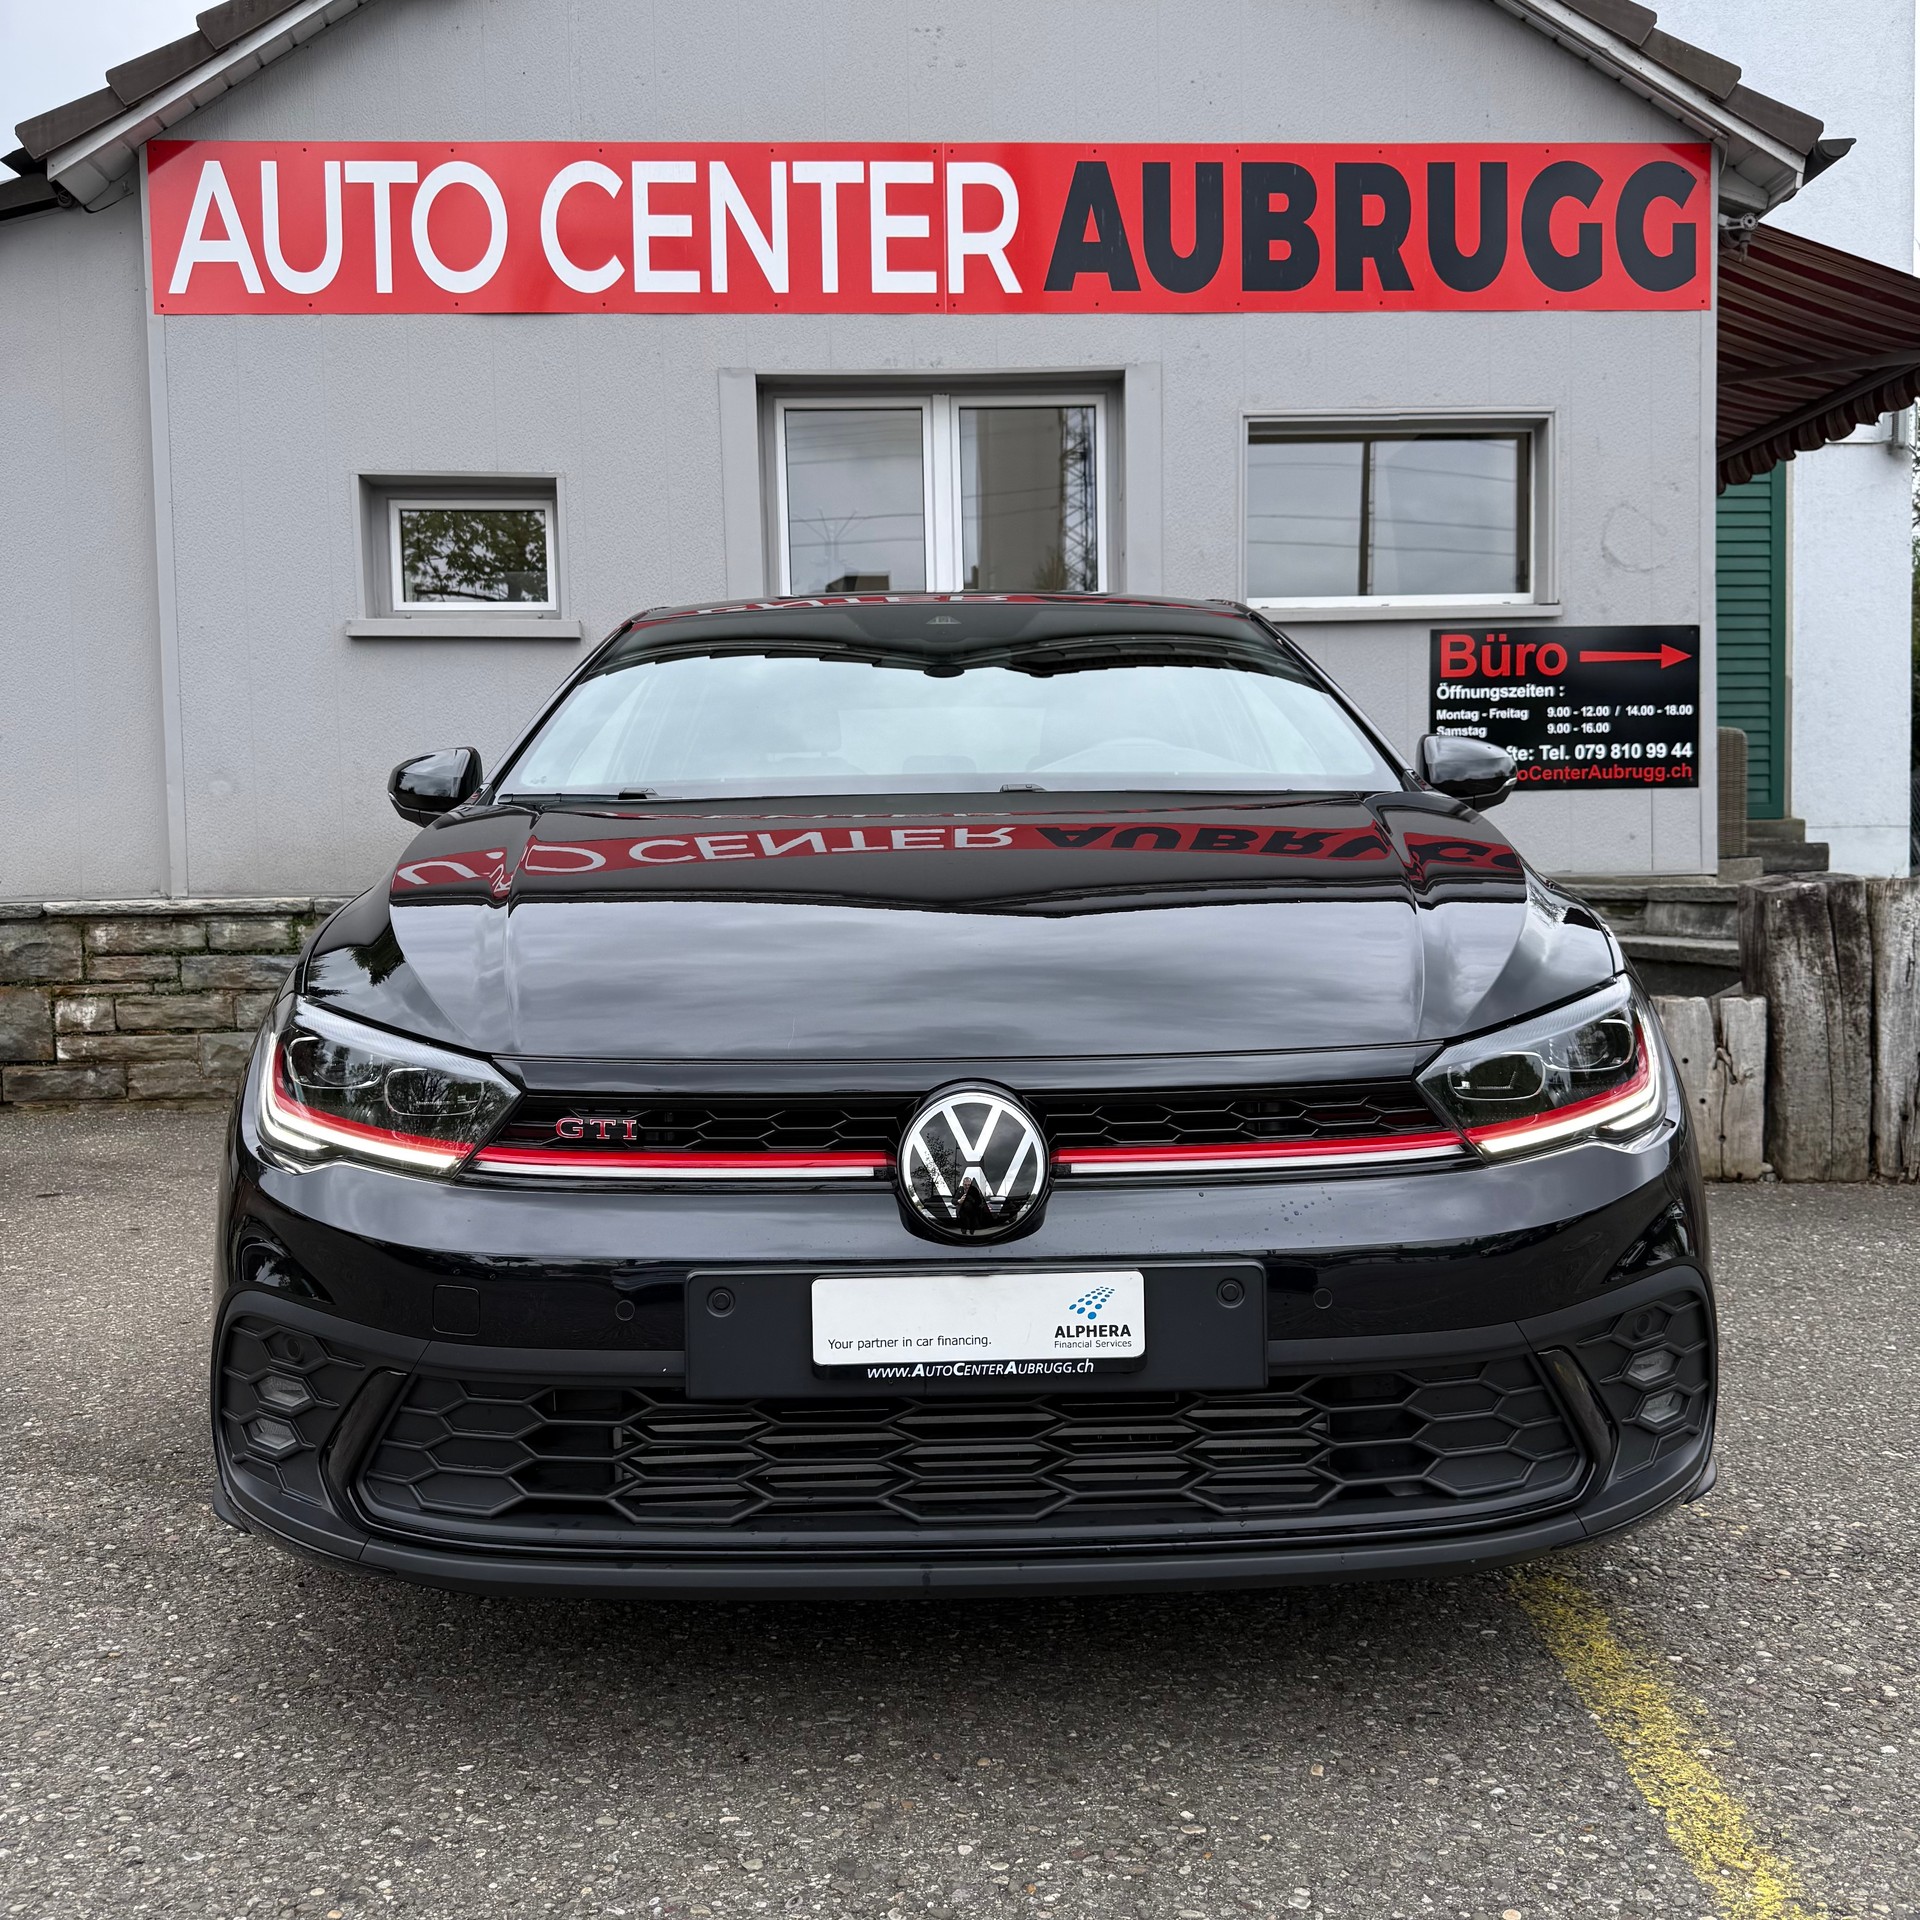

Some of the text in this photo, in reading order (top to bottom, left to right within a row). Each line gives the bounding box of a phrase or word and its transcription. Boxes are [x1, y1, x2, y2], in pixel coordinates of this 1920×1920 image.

[168, 160, 1698, 295] AUTO CENTER AUBRUGG
[1439, 633, 1568, 679] Büro
[1436, 682, 1555, 702] Öffnungszeiten
[1436, 709, 1480, 722] Montag
[1489, 707, 1530, 721] Freitag
[1546, 706, 1572, 718] 9.00
[1580, 705, 1611, 718] 12.00
[1625, 704, 1656, 717] 14.00
[1664, 704, 1694, 716] 18.00
[1436, 725, 1488, 738] Samstag
[1546, 722, 1572, 734] 9.00
[1580, 722, 1611, 734] 16.00
[1539, 744, 1571, 761] Tel.
[1574, 743, 1607, 760] 079
[1610, 743, 1643, 759] 810
[1645, 742, 1668, 759] 99
[1670, 742, 1694, 759] 44
[1517, 762, 1693, 782] oCenterAubrugg.ch
[555, 1117, 638, 1141] GTI
[1054, 1324, 1132, 1338] ALPHERA
[828, 1335, 992, 1351] Your partner in car financing.
[1054, 1339, 1132, 1349] Financial Services
